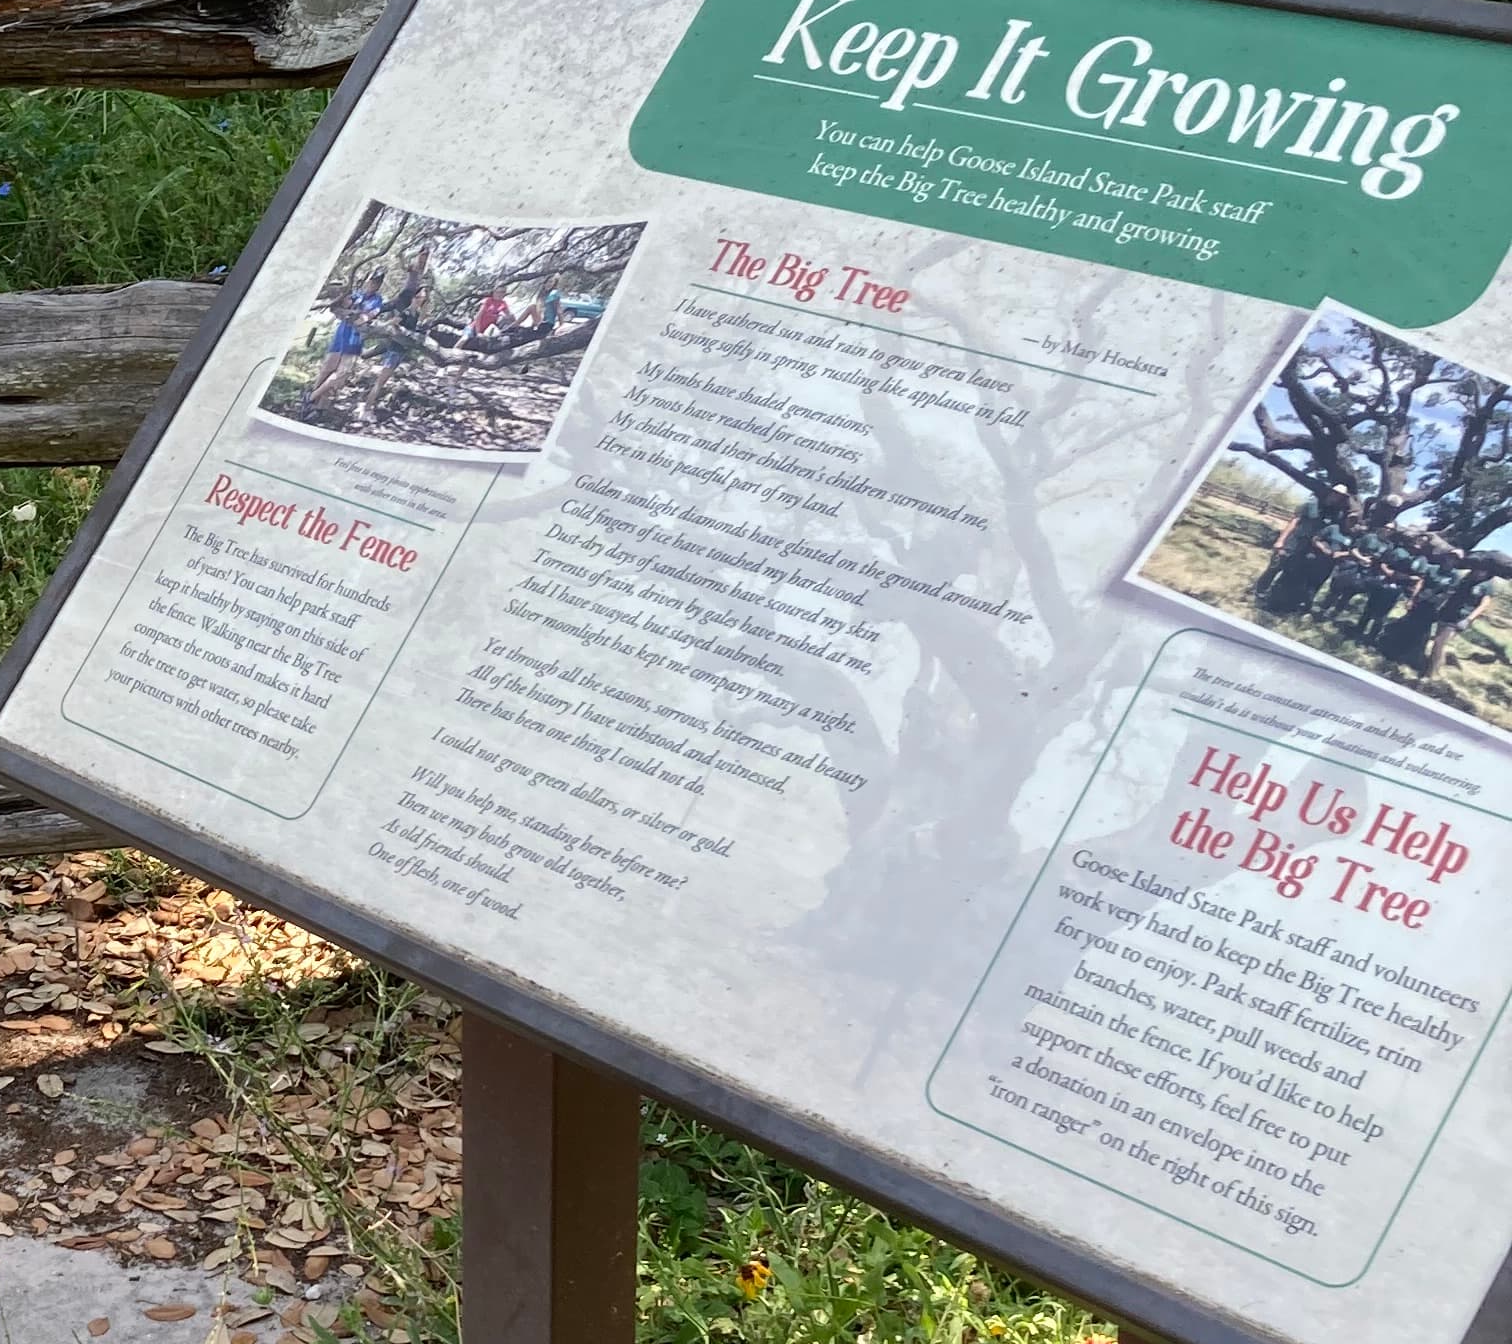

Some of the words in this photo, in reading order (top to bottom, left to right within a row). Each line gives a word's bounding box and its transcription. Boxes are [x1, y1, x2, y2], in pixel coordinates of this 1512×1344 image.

[965, 19, 1050, 104] It
[1066, 36, 1460, 200] Growing
[807, 153, 857, 187] keep
[859, 165, 895, 188] the
[894, 170, 936, 203] Big
[937, 178, 988, 207] Tree
[987, 188, 1074, 229] healthy
[1072, 211, 1124, 234] and
[1115, 222, 1221, 261] growing.
[816, 119, 857, 145] You
[859, 135, 895, 153] can
[896, 134, 945, 168] help
[948, 145, 1016, 176] Goose
[1016, 158, 1092, 190] Island
[1088, 171, 1149, 201] State
[1149, 183, 1208, 214] Park
[1208, 201, 1274, 224] staff
[711, 239, 767, 280] The
[768, 252, 829, 301] Big
[835, 265, 912, 313] Tree
[636, 361, 665, 383] My
[662, 366, 704, 389] limbs
[701, 376, 737, 398] have
[735, 386, 792, 411] shaded
[780, 404, 874, 436] generations;
[1041, 334, 1065, 355] by
[1060, 339, 1101, 364] Mary
[1100, 349, 1168, 377] Hoekstra
[206, 473, 297, 529] Respect
[298, 506, 340, 544] the
[340, 519, 418, 571] Fence
[608, 410, 637, 432] My
[634, 417, 693, 444] children
[689, 437, 726, 453] and
[719, 441, 758, 462] their
[825, 471, 888, 500] children
[887, 493, 967, 521] surround
[959, 513, 988, 531] me,
[183, 524, 205, 543] The
[203, 532, 224, 555] Big
[224, 538, 250, 560] Tree
[248, 548, 270, 567] has
[268, 560, 319, 585] survived
[315, 572, 336, 592] for
[333, 579, 391, 612] hundreds
[186, 556, 206, 570] of
[196, 563, 233, 581] years!
[231, 570, 256, 591] You
[255, 585, 276, 599] can
[275, 586, 302, 612] help
[297, 601, 331, 619] park
[328, 612, 363, 629] staff
[574, 474, 623, 500] Golden
[621, 493, 681, 518] sunlight
[677, 505, 750, 538] diamonds
[747, 525, 785, 549] have
[777, 538, 843, 565] glinted
[836, 558, 859, 572] on
[857, 560, 886, 580] the
[879, 573, 949, 597] ground
[941, 582, 1009, 616] around
[1002, 609, 1033, 625] me
[154, 569, 181, 595] keep
[179, 584, 192, 595] it
[189, 582, 232, 614] healthy
[229, 597, 248, 620] by
[244, 608, 287, 636] staying
[284, 624, 301, 638] on
[301, 627, 326, 647] this
[324, 637, 349, 656] side
[349, 647, 370, 662] of
[380, 818, 401, 834] As
[398, 825, 428, 844] old
[413, 832, 467, 863] friends
[463, 853, 515, 884] should.
[1169, 807, 1235, 861] the
[1239, 828, 1319, 899] Big
[1330, 856, 1431, 929] Tree
[1188, 746, 1288, 823] Help
[1298, 781, 1358, 836] Us
[1363, 804, 1469, 884] Help
[1059, 885, 1105, 912] work
[1108, 903, 1146, 931] very
[1144, 911, 1194, 944] hard
[1192, 935, 1214, 952] to
[1214, 937, 1261, 975] keep
[1262, 958, 1297, 984] the
[1297, 969, 1336, 1004] Big
[1337, 983, 1385, 1017] Tree
[1384, 1002, 1465, 1052] healthy
[1072, 849, 1130, 883] Goose
[1128, 870, 1191, 905] Island
[1187, 891, 1237, 923] State
[1237, 909, 1285, 941] Park
[1285, 933, 1338, 957] staff
[1329, 949, 1374, 973] and
[1374, 964, 1480, 1013] volunteers
[1054, 916, 1085, 941] for
[1080, 932, 1119, 955] you
[1121, 946, 1142, 963] to
[1143, 956, 1197, 988] enjoy.
[1200, 972, 1248, 1005] Park
[1247, 996, 1300, 1021] staff
[1292, 1007, 1371, 1056] fertilize,
[1376, 1045, 1422, 1073] trim
[1073, 959, 1156, 1011] branches,
[1163, 1000, 1216, 1035] water,
[1215, 1024, 1264, 1049] pull
[1264, 1040, 1323, 1073] weeds
[1322, 1066, 1368, 1090] and
[1021, 1022, 1094, 1059] support
[1094, 1047, 1142, 1079] these
[1143, 1070, 1207, 1110] efforts,
[1209, 1093, 1250, 1123] feel
[1246, 1109, 1286, 1139] free
[1288, 1131, 1311, 1149] to
[1307, 1142, 1352, 1166] put
[1024, 984, 1105, 1026] maintain
[1107, 1013, 1140, 1039] the
[1139, 1025, 1192, 1062] fence.
[1196, 1048, 1224, 1070] If
[1271, 1077, 1312, 1109] like
[1313, 1100, 1336, 1119] to
[1336, 1104, 1384, 1143] help
[1011, 1056, 1024, 1069] a
[1025, 1056, 1108, 1105] donation
[1109, 1092, 1130, 1114] in
[1131, 1107, 1157, 1125] an
[1158, 1118, 1245, 1162] envelope
[1243, 1149, 1288, 1180] into
[1290, 1169, 1325, 1197] the
[1099, 1132, 1125, 1152] on
[1127, 1140, 1161, 1166] the
[1160, 1157, 1210, 1188] right
[1210, 1179, 1243, 1199] of
[1235, 1182, 1274, 1216] this
[1273, 1206, 1318, 1237] sign.
